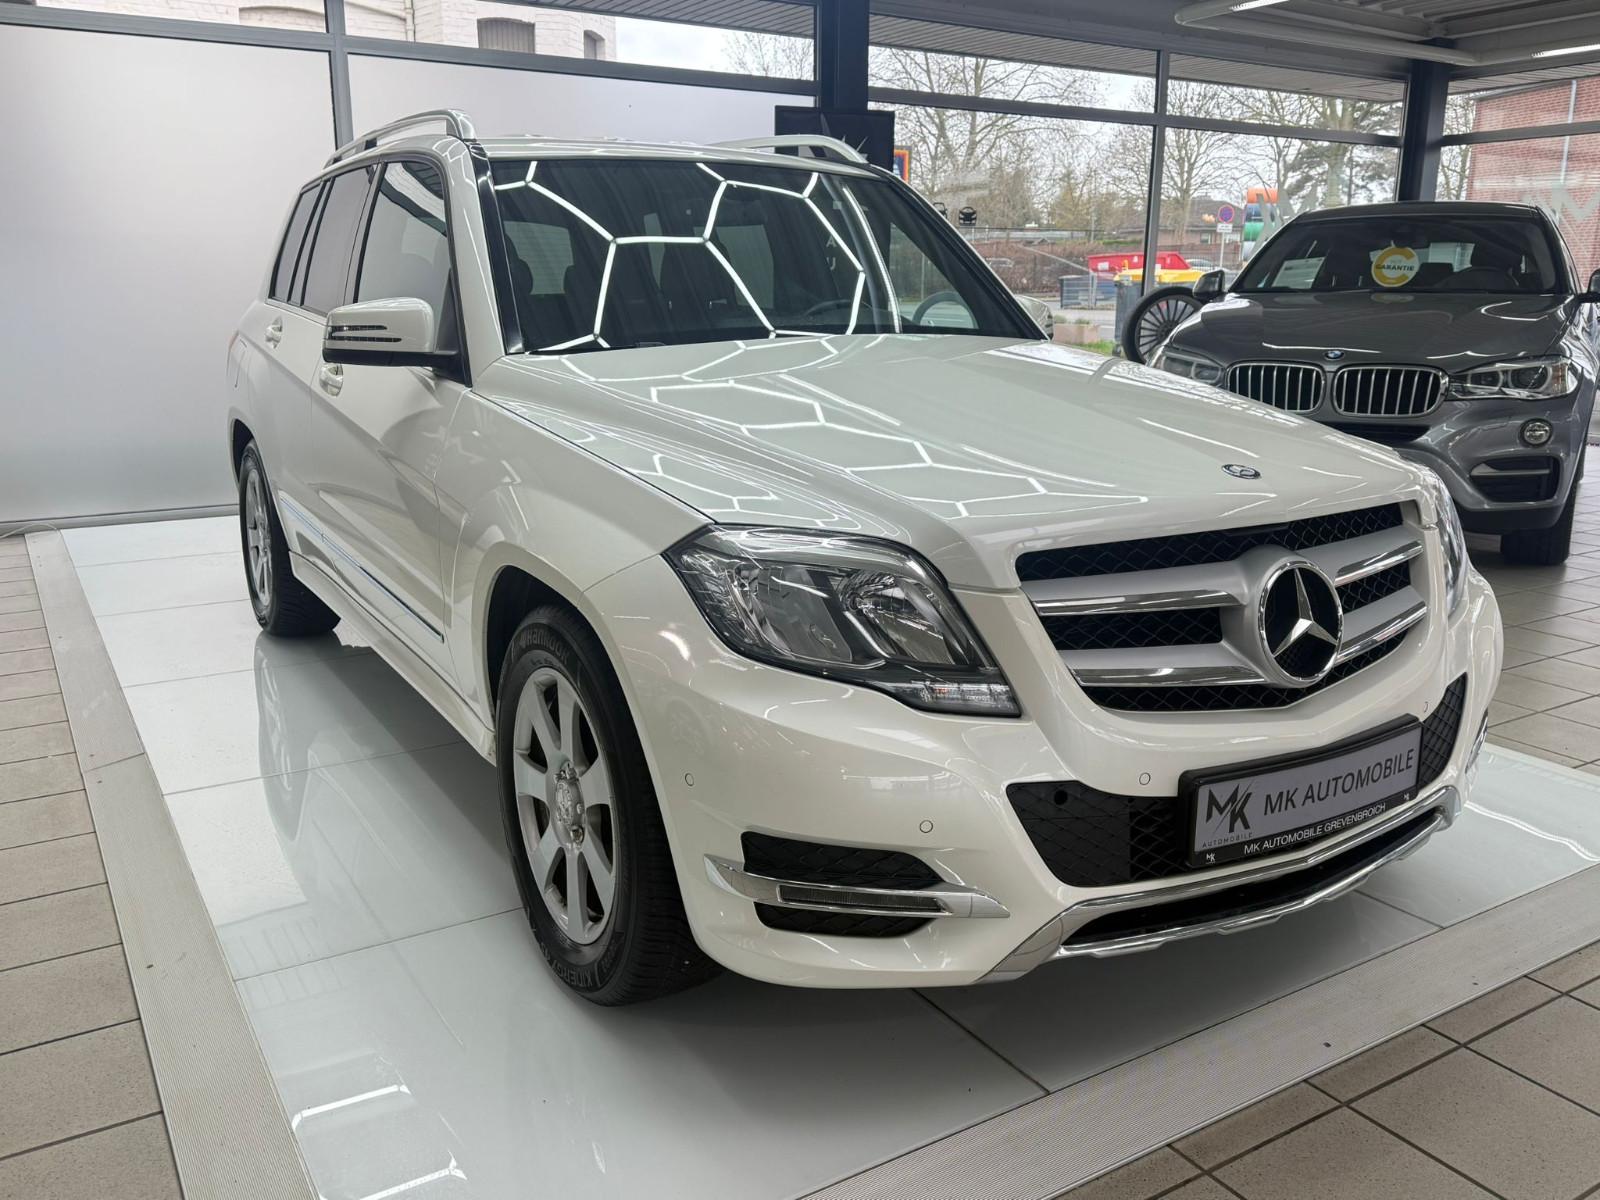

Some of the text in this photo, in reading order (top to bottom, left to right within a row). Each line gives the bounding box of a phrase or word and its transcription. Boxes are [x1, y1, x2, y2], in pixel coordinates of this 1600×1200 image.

[1264, 749, 1414, 815] MK AUTOMOBILE
[1205, 783, 1253, 833] MK
[1244, 802, 1386, 855] MK AUTOMOBILE GREVENBROICH
[1202, 832, 1254, 849] AUTOMOBILE
